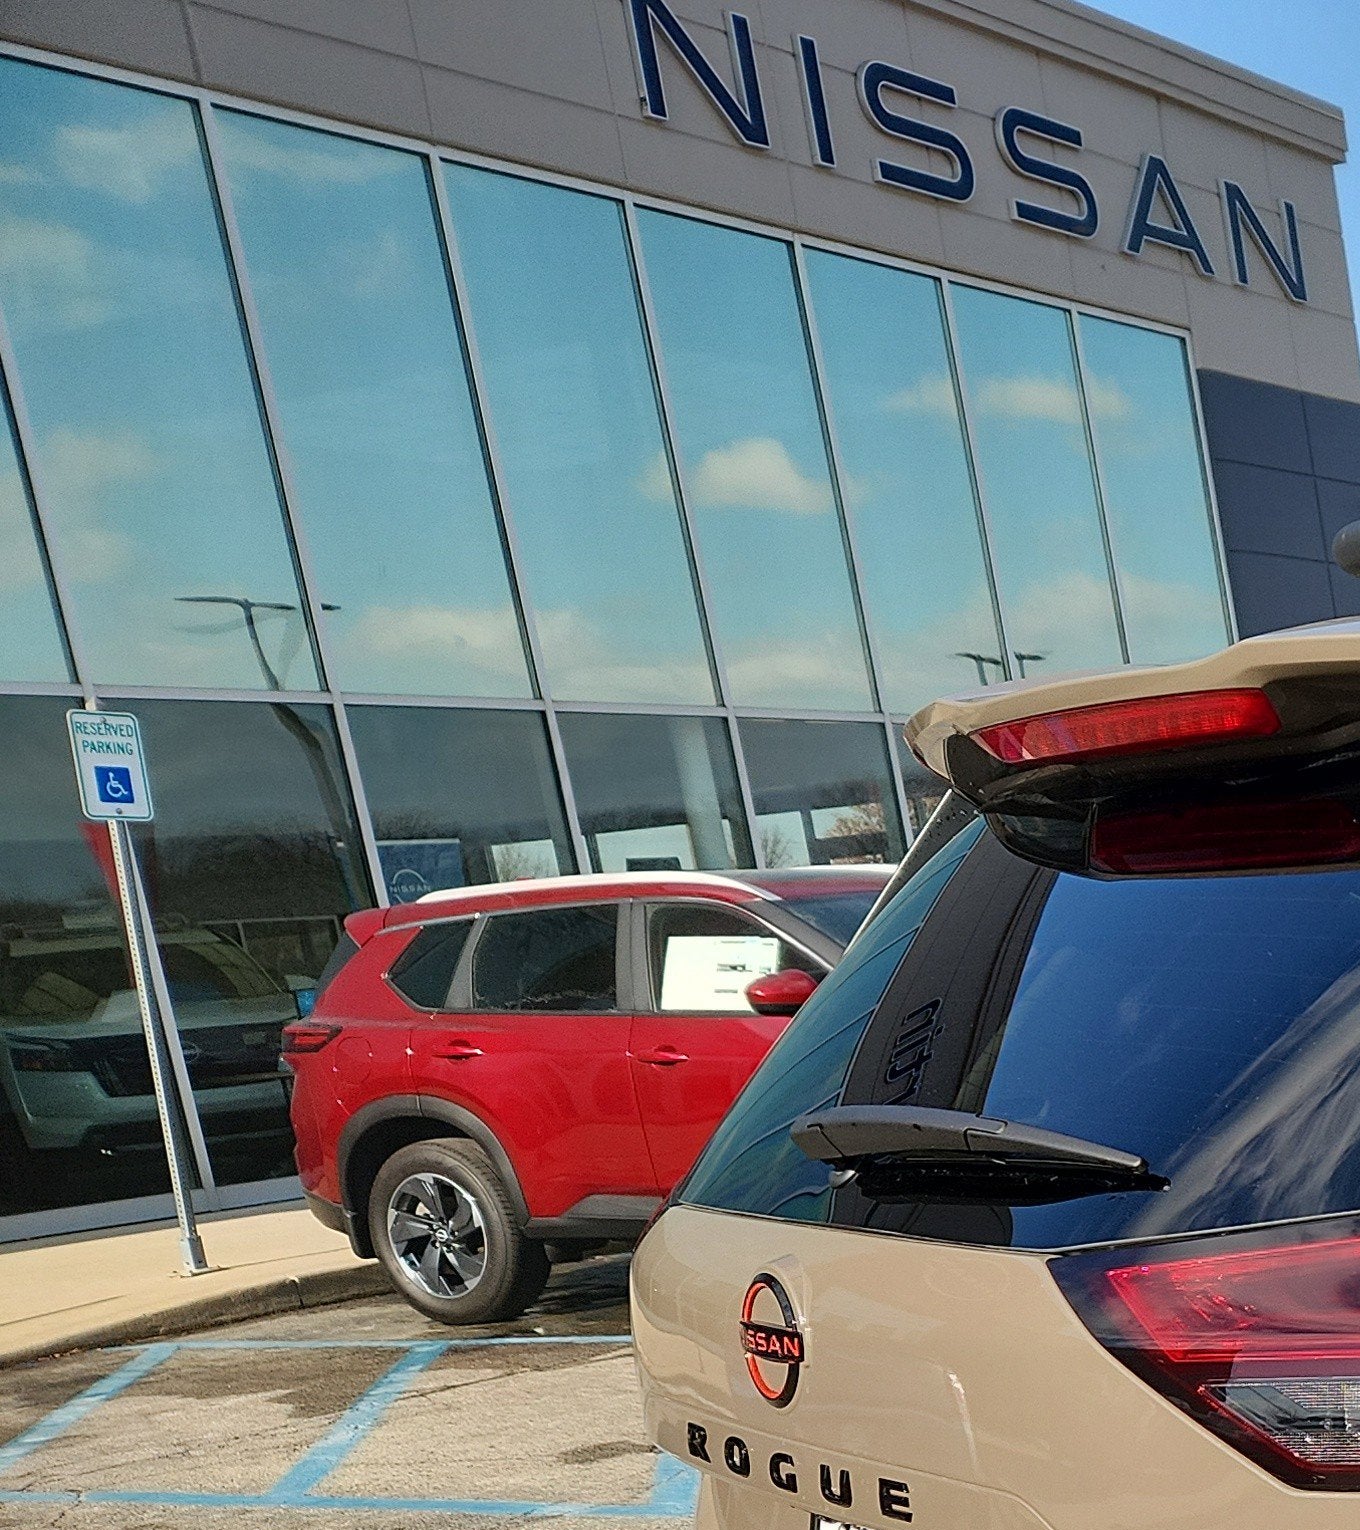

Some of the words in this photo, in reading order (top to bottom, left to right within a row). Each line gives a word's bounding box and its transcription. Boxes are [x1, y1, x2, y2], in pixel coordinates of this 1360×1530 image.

[630, 0, 1307, 302] NISSAN
[74, 721, 134, 737] RESERVED
[82, 739, 134, 756] PARKING
[389, 884, 431, 894] NISSAN
[686, 1421, 914, 1524] ROGUE
